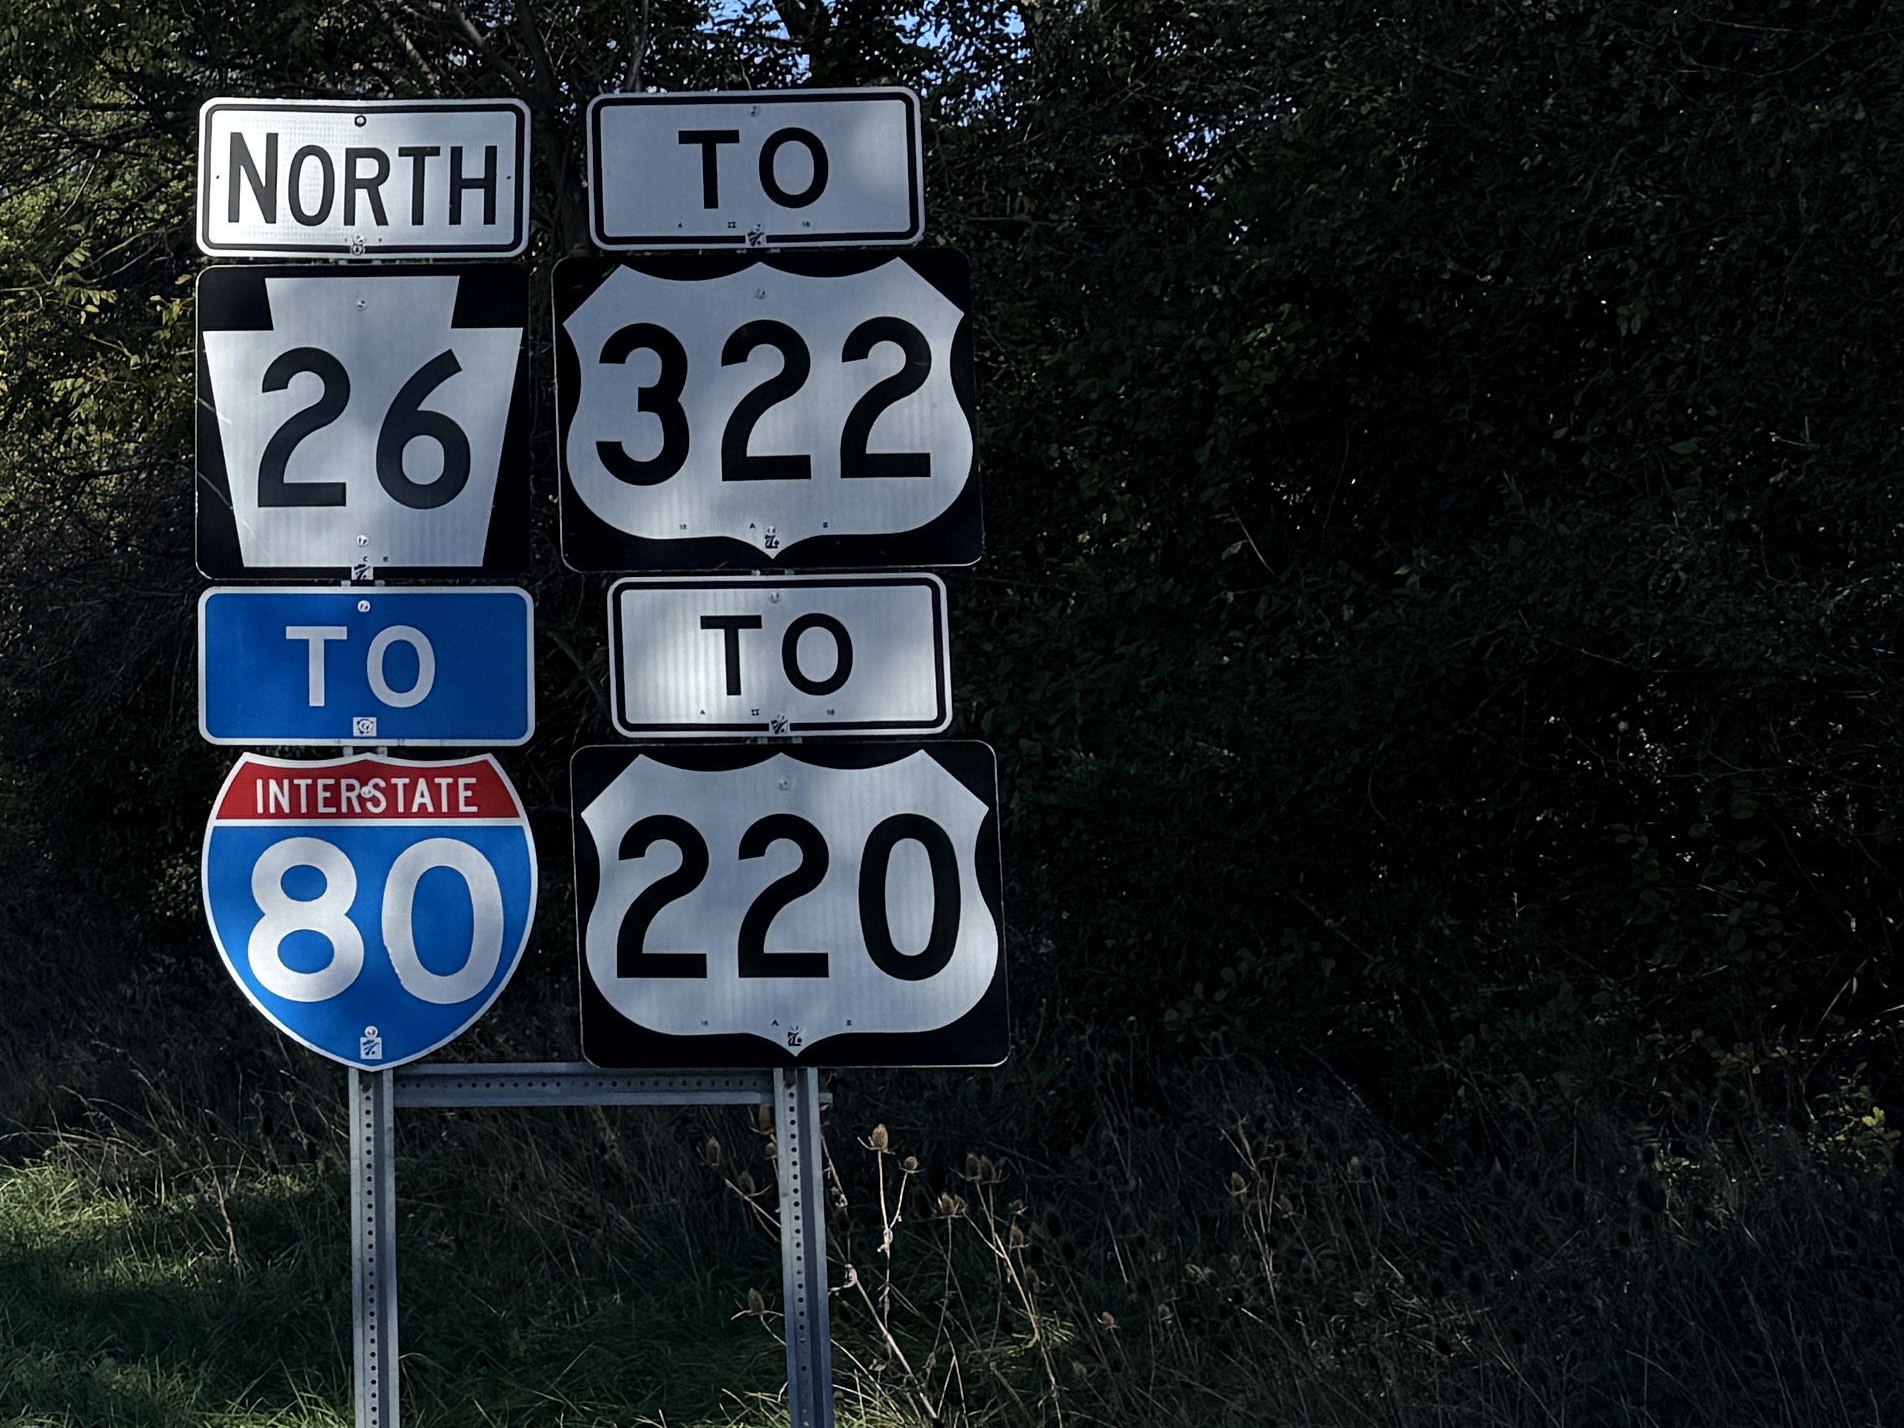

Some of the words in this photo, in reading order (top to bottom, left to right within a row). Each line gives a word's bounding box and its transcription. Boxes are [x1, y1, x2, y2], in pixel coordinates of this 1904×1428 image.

[227, 131, 498, 227] NORTH
[677, 127, 829, 210] TO
[257, 346, 472, 511] 26
[595, 316, 932, 487] 322
[285, 625, 436, 708] TO
[699, 612, 854, 697] TO
[255, 777, 478, 814] INTERSTATE
[247, 836, 504, 1004] 80
[616, 813, 962, 982] 220
